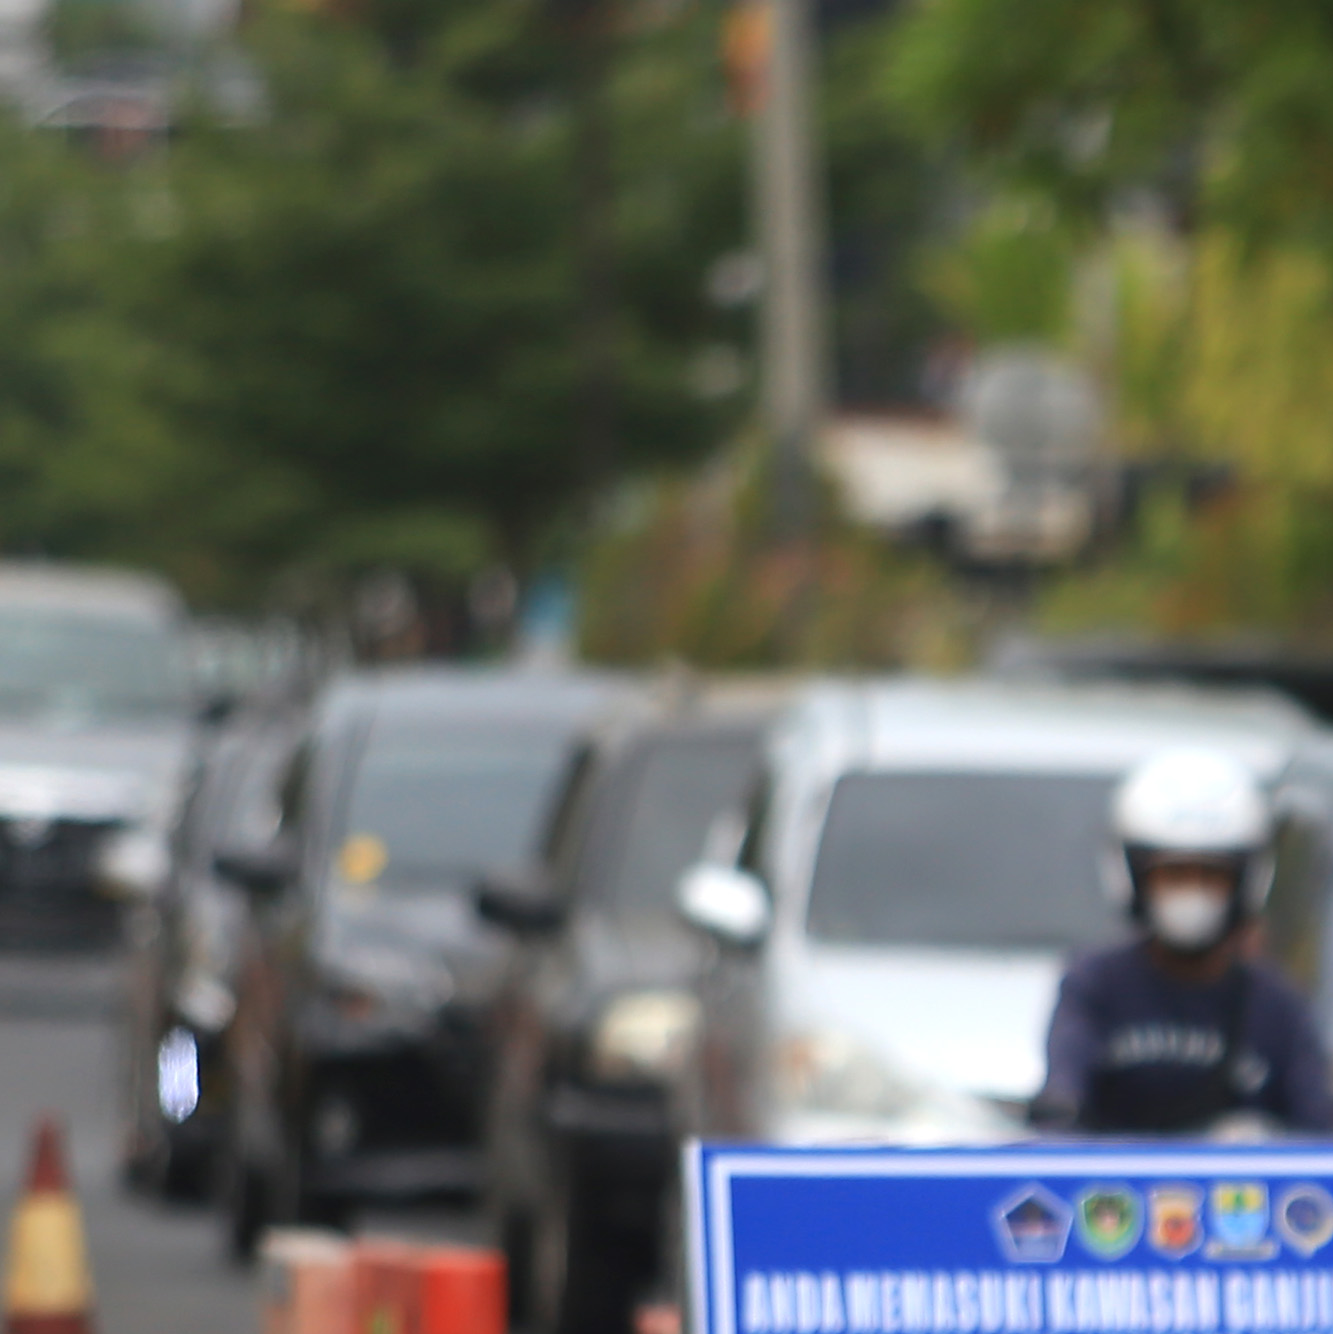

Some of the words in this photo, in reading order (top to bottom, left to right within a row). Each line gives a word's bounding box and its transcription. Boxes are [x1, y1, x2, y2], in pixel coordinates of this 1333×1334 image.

[746, 1271, 844, 1333] ANDA
[847, 1271, 1044, 1333] MEMASUKI
[1047, 1271, 1220, 1333] KAWASAN
